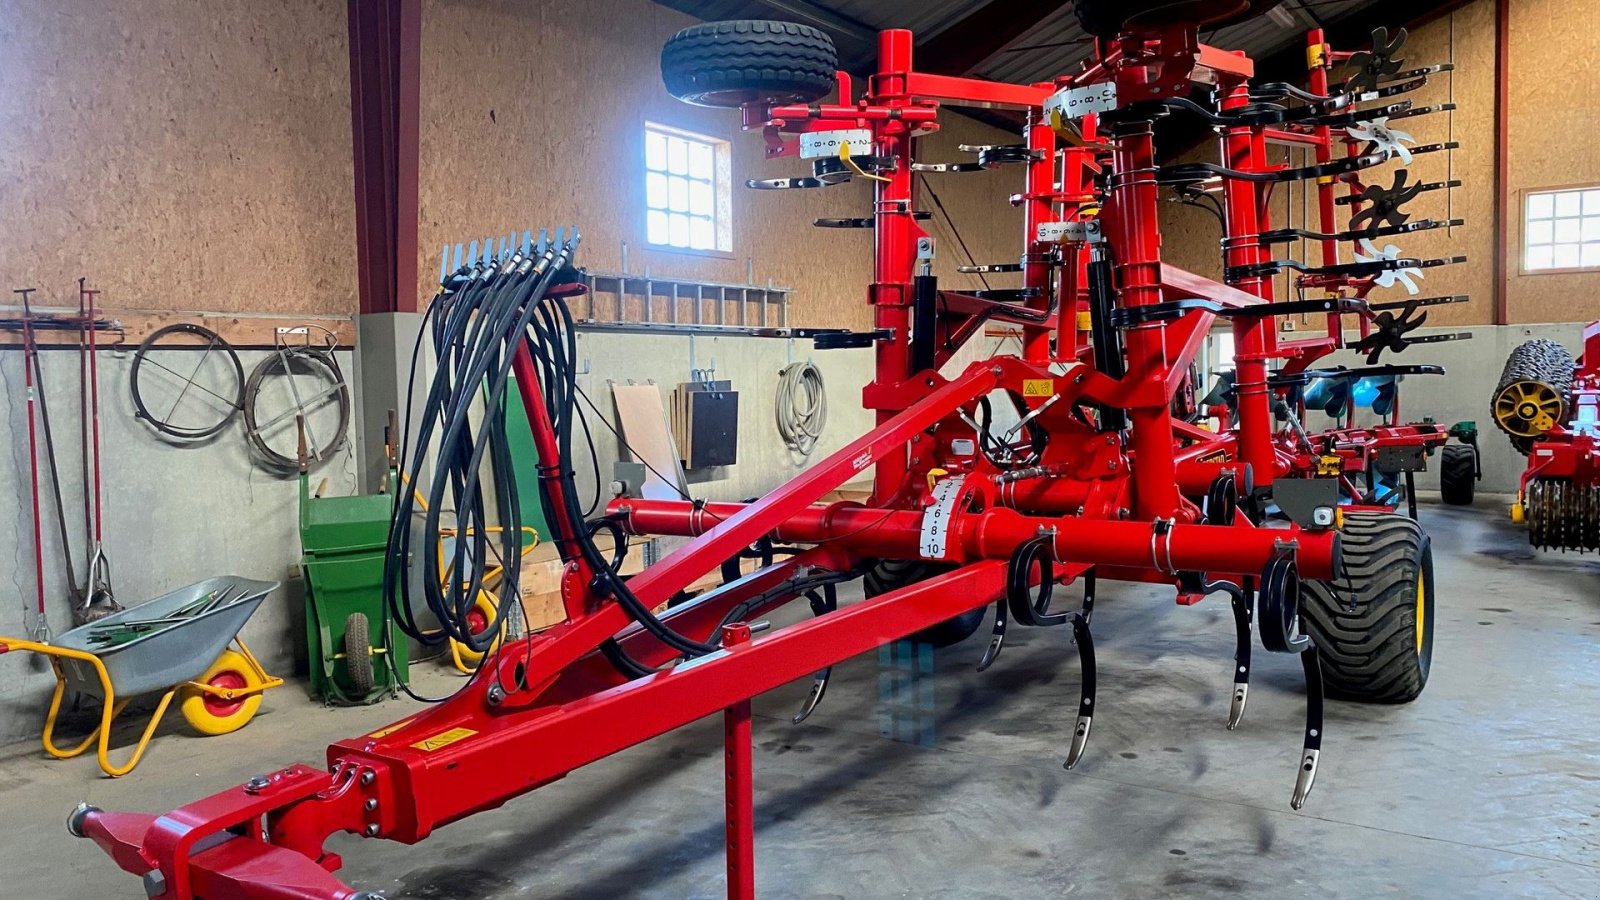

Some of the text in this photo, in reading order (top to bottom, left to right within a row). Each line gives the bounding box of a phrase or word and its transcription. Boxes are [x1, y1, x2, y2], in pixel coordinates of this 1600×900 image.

[1084, 95, 1094, 103] 8
[1102, 89, 1112, 103] 10
[1040, 228, 1047, 237] 10
[940, 494, 946, 502] 4
[934, 508, 941, 518] 6
[931, 525, 938, 535] 8
[927, 544, 939, 554] 10
